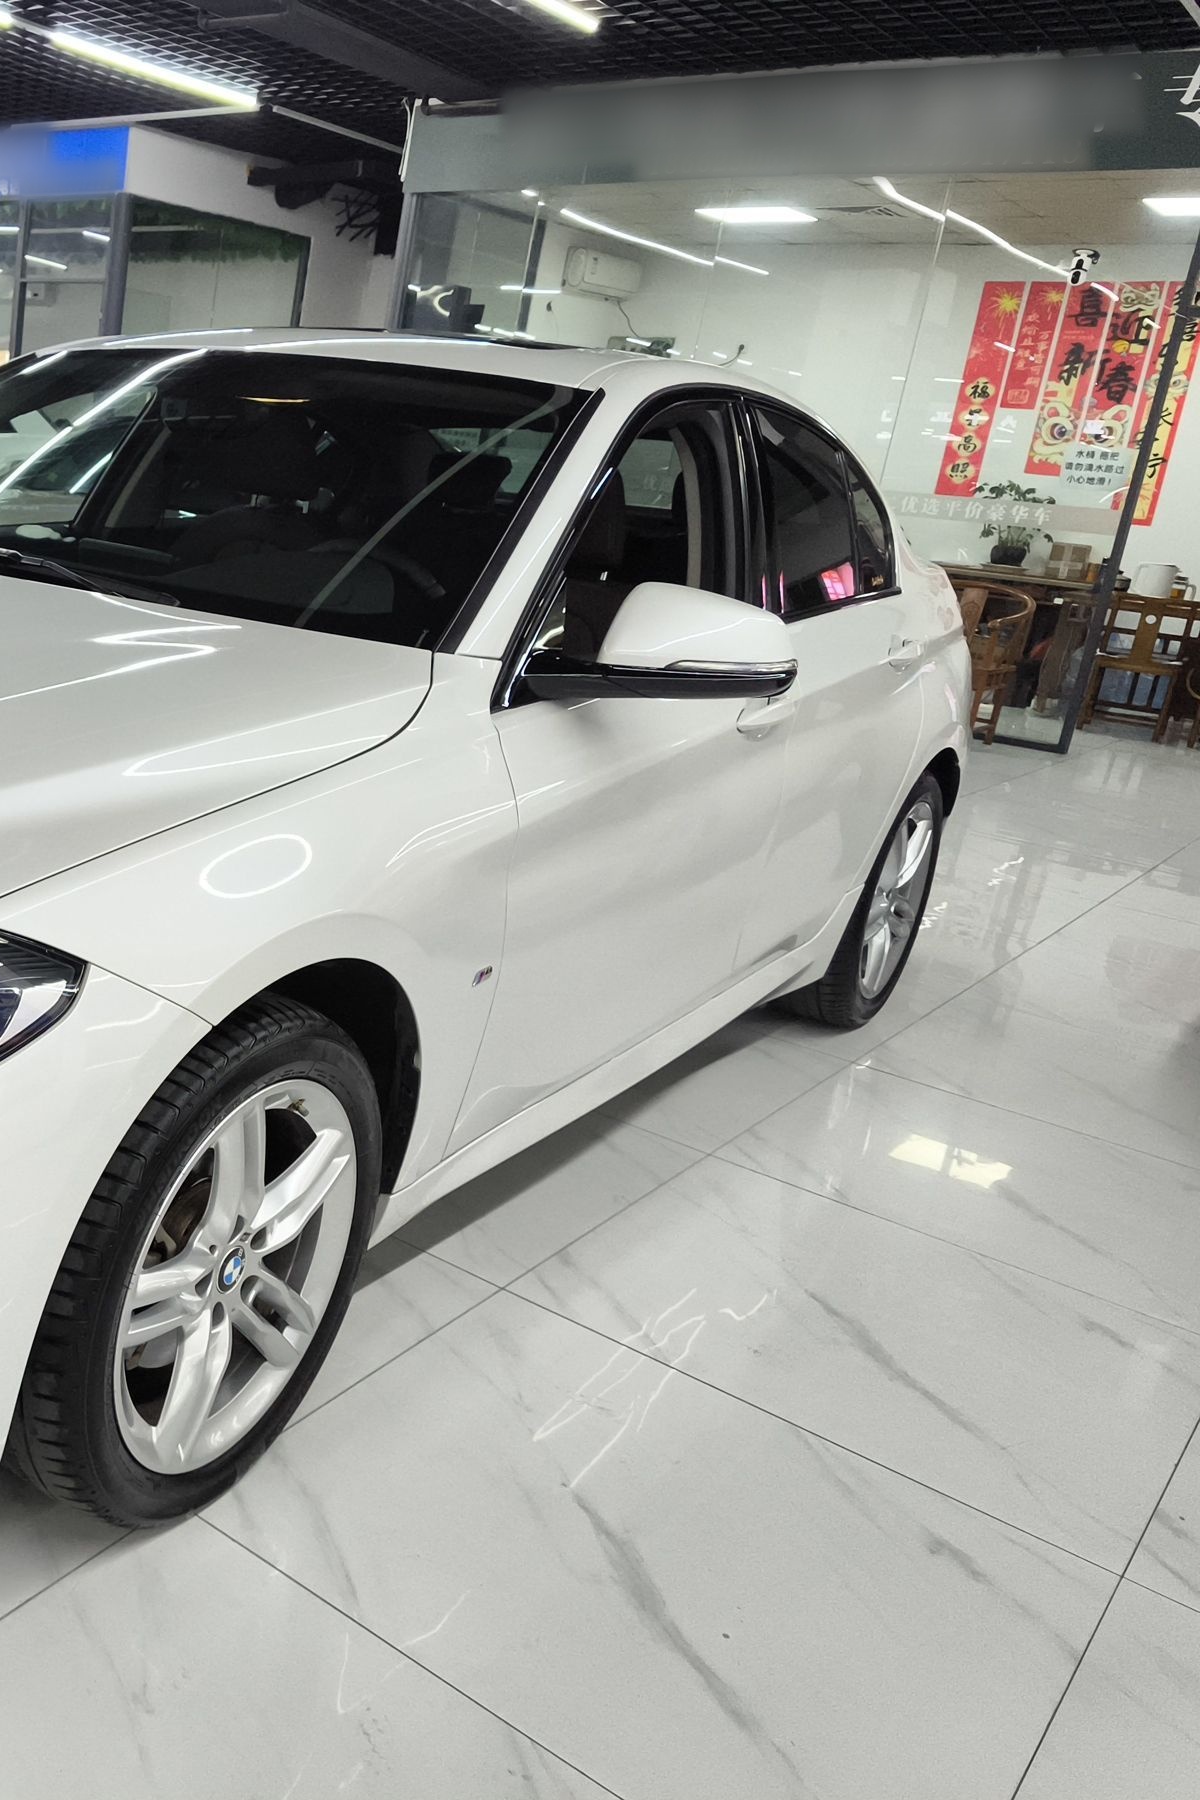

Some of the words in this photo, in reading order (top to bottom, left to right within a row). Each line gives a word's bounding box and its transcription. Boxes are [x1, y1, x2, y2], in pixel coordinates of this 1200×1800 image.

[892, 495, 1053, 526] 优选平价豪华车
